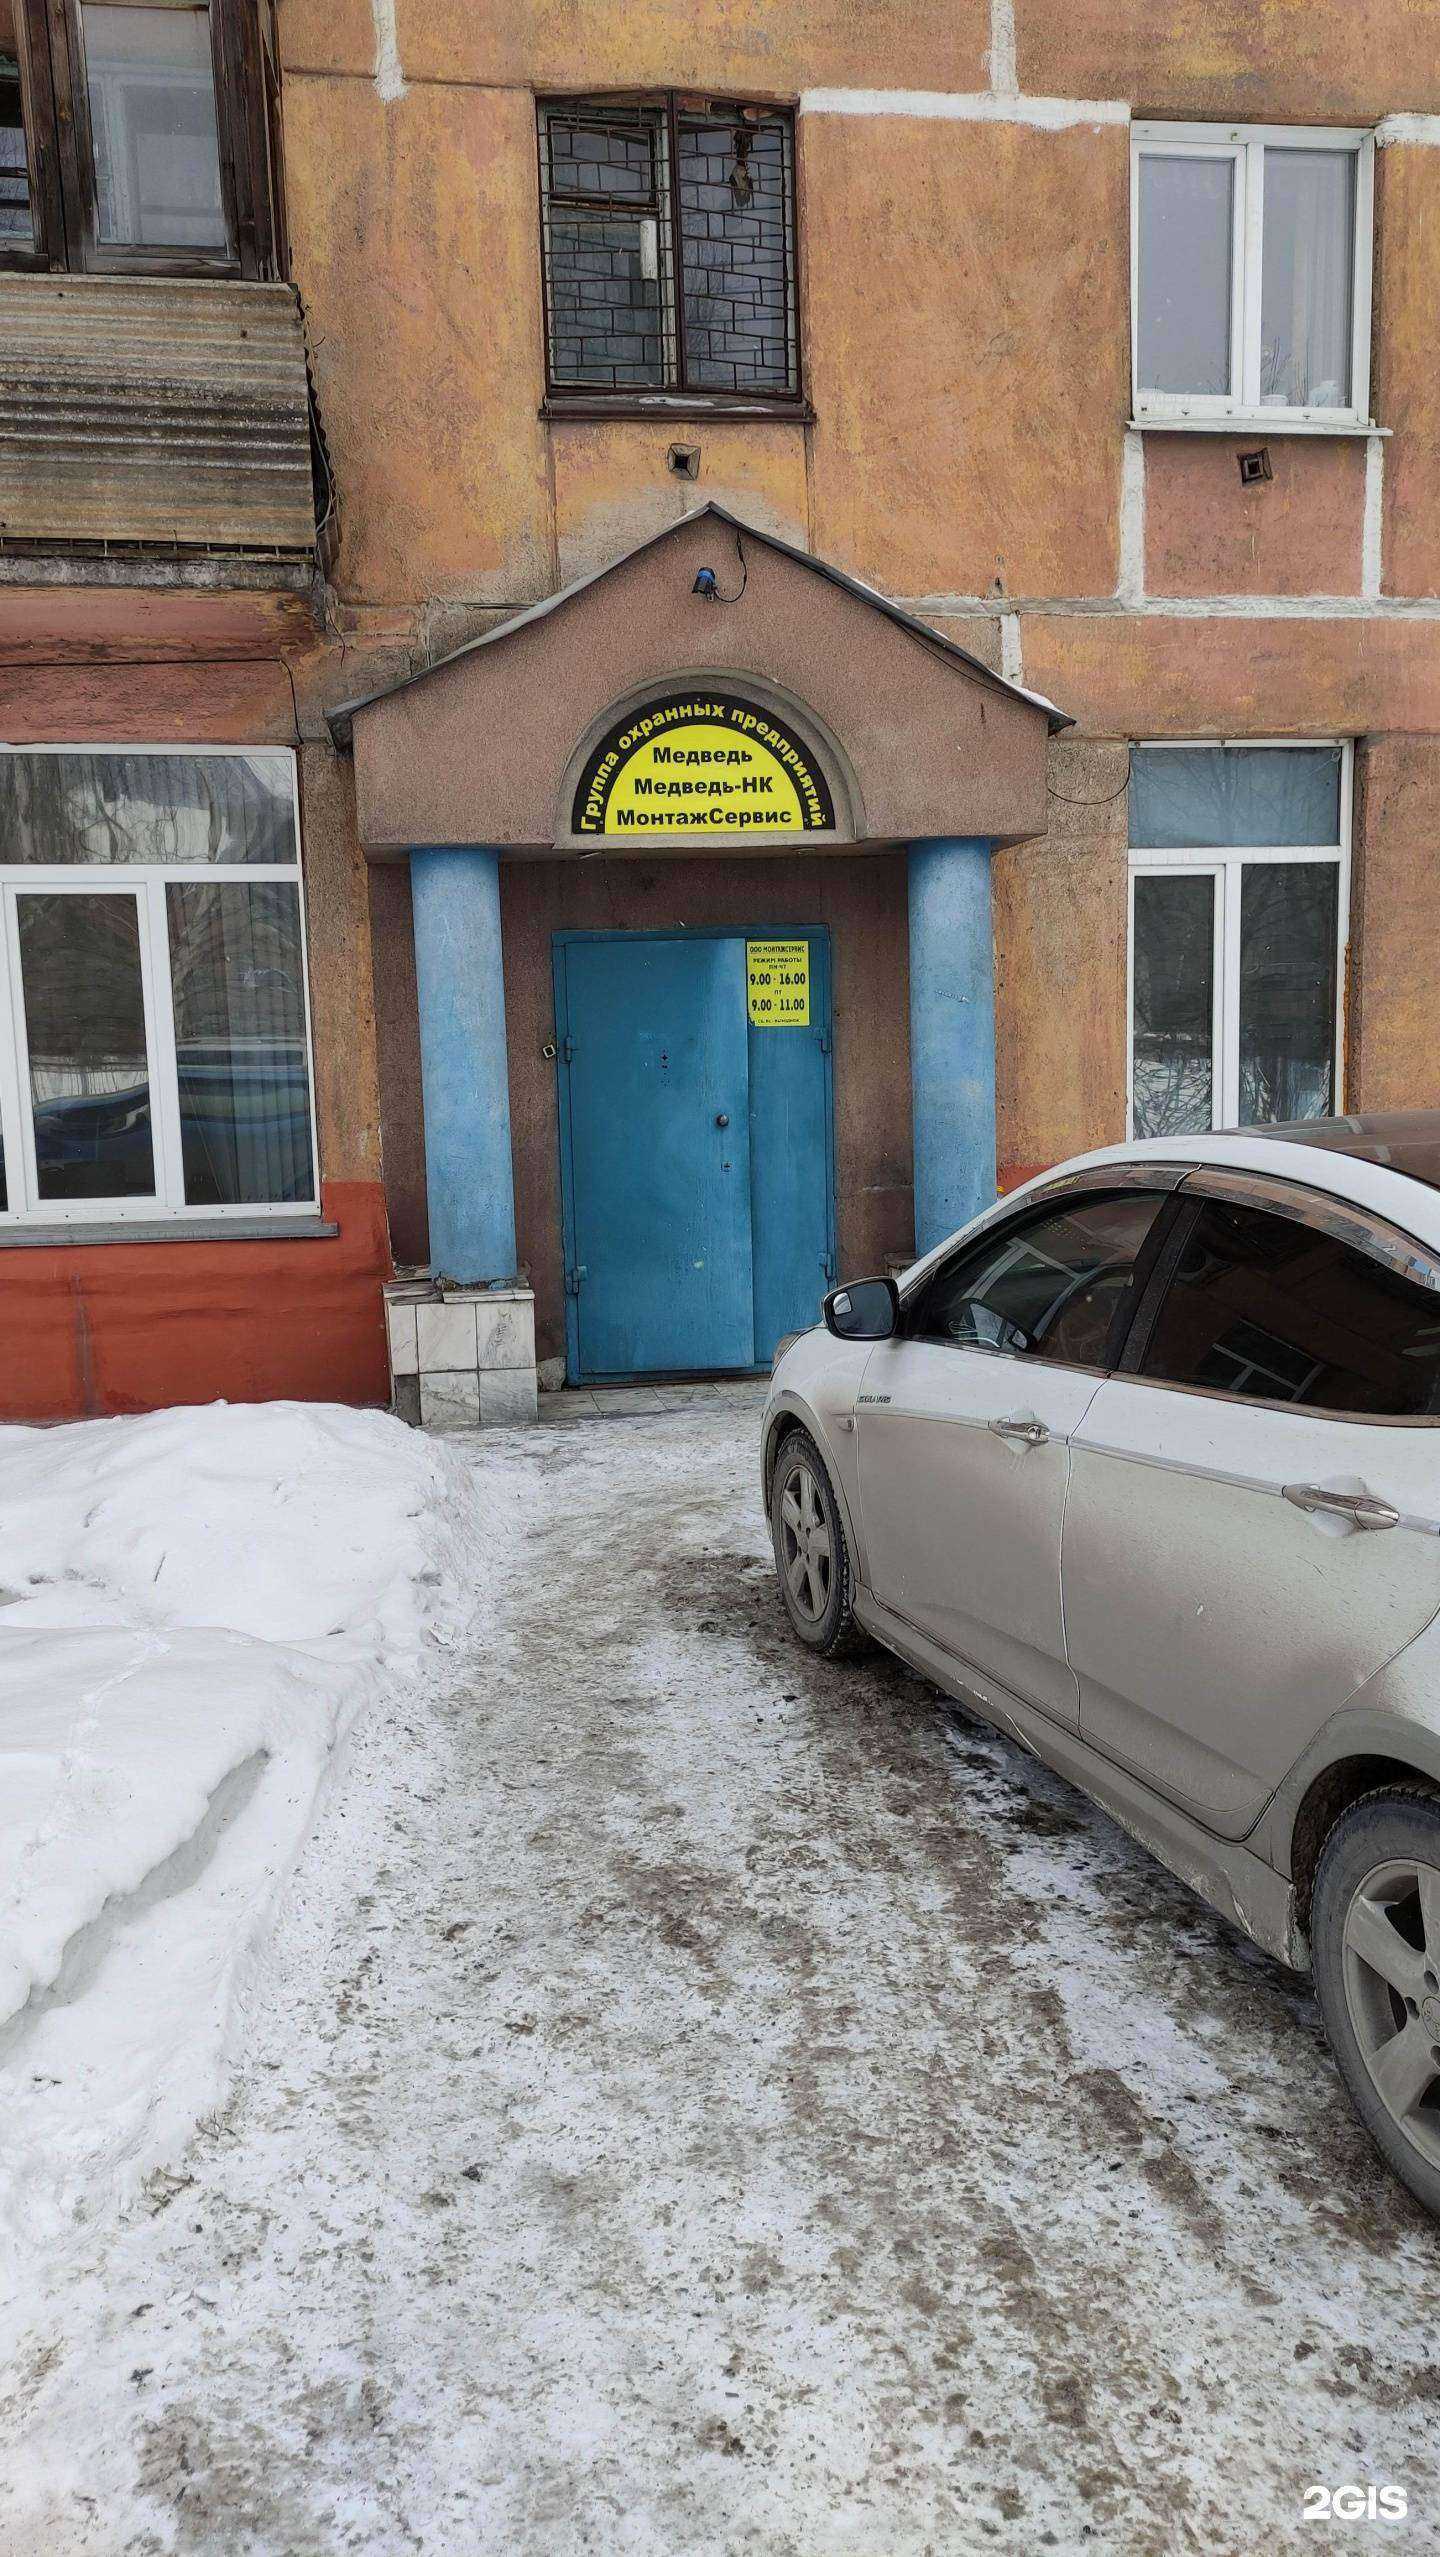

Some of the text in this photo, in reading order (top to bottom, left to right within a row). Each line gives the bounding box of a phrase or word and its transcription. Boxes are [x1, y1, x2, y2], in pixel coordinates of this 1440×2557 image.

[653, 746, 753, 765] Медведь
[580, 703, 826, 831] Группа охранных предприятий
[634, 776, 774, 797] Медведь-НК
[617, 808, 792, 827] МонтажСервис
[750, 973, 771, 985] 9.00
[779, 973, 806, 985] 16.00
[751, 999, 772, 1011] 9.00
[779, 999, 805, 1011] 11.00
